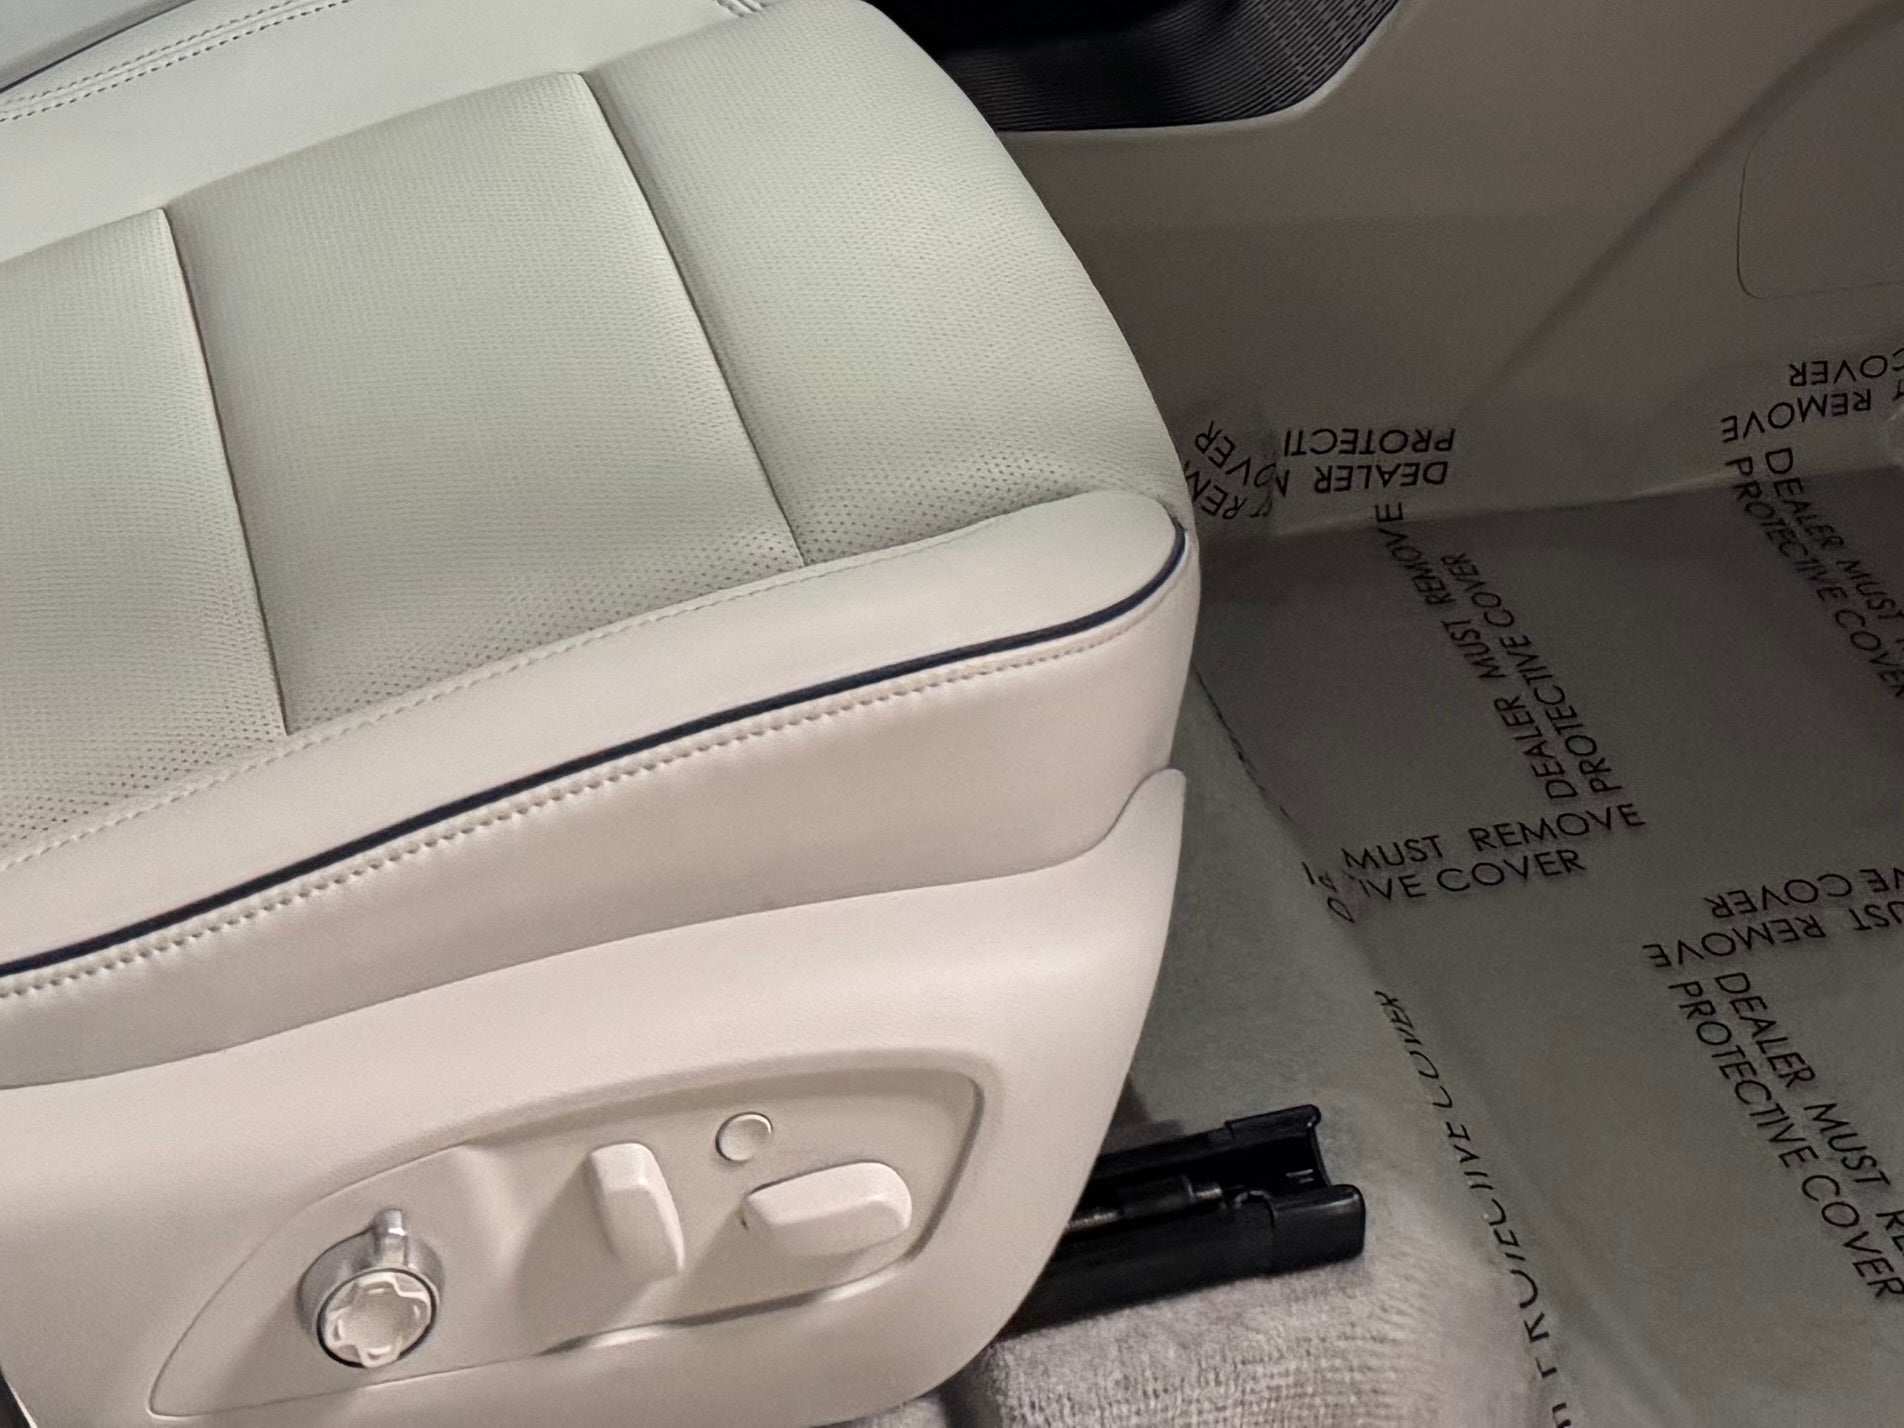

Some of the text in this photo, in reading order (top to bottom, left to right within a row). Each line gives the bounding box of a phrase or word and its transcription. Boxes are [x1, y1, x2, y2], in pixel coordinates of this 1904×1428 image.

[1720, 388, 1873, 443] REMOVE
[1313, 460, 1449, 495] DEALER
[1440, 617, 1508, 681] MUST
[1441, 552, 1623, 795] PROTECTIVE COVER
[1493, 694, 1579, 800] DEALER
[1340, 802, 1647, 872] MUST REMOVE
[1436, 848, 1587, 893] COVER
[1701, 872, 1854, 921] COVER
[1641, 913, 1827, 969] REMOVE
[1667, 980, 1819, 1170] PROTECTIVE
[1713, 971, 1817, 1089] DEALER
[1802, 1102, 1892, 1187] MUST
